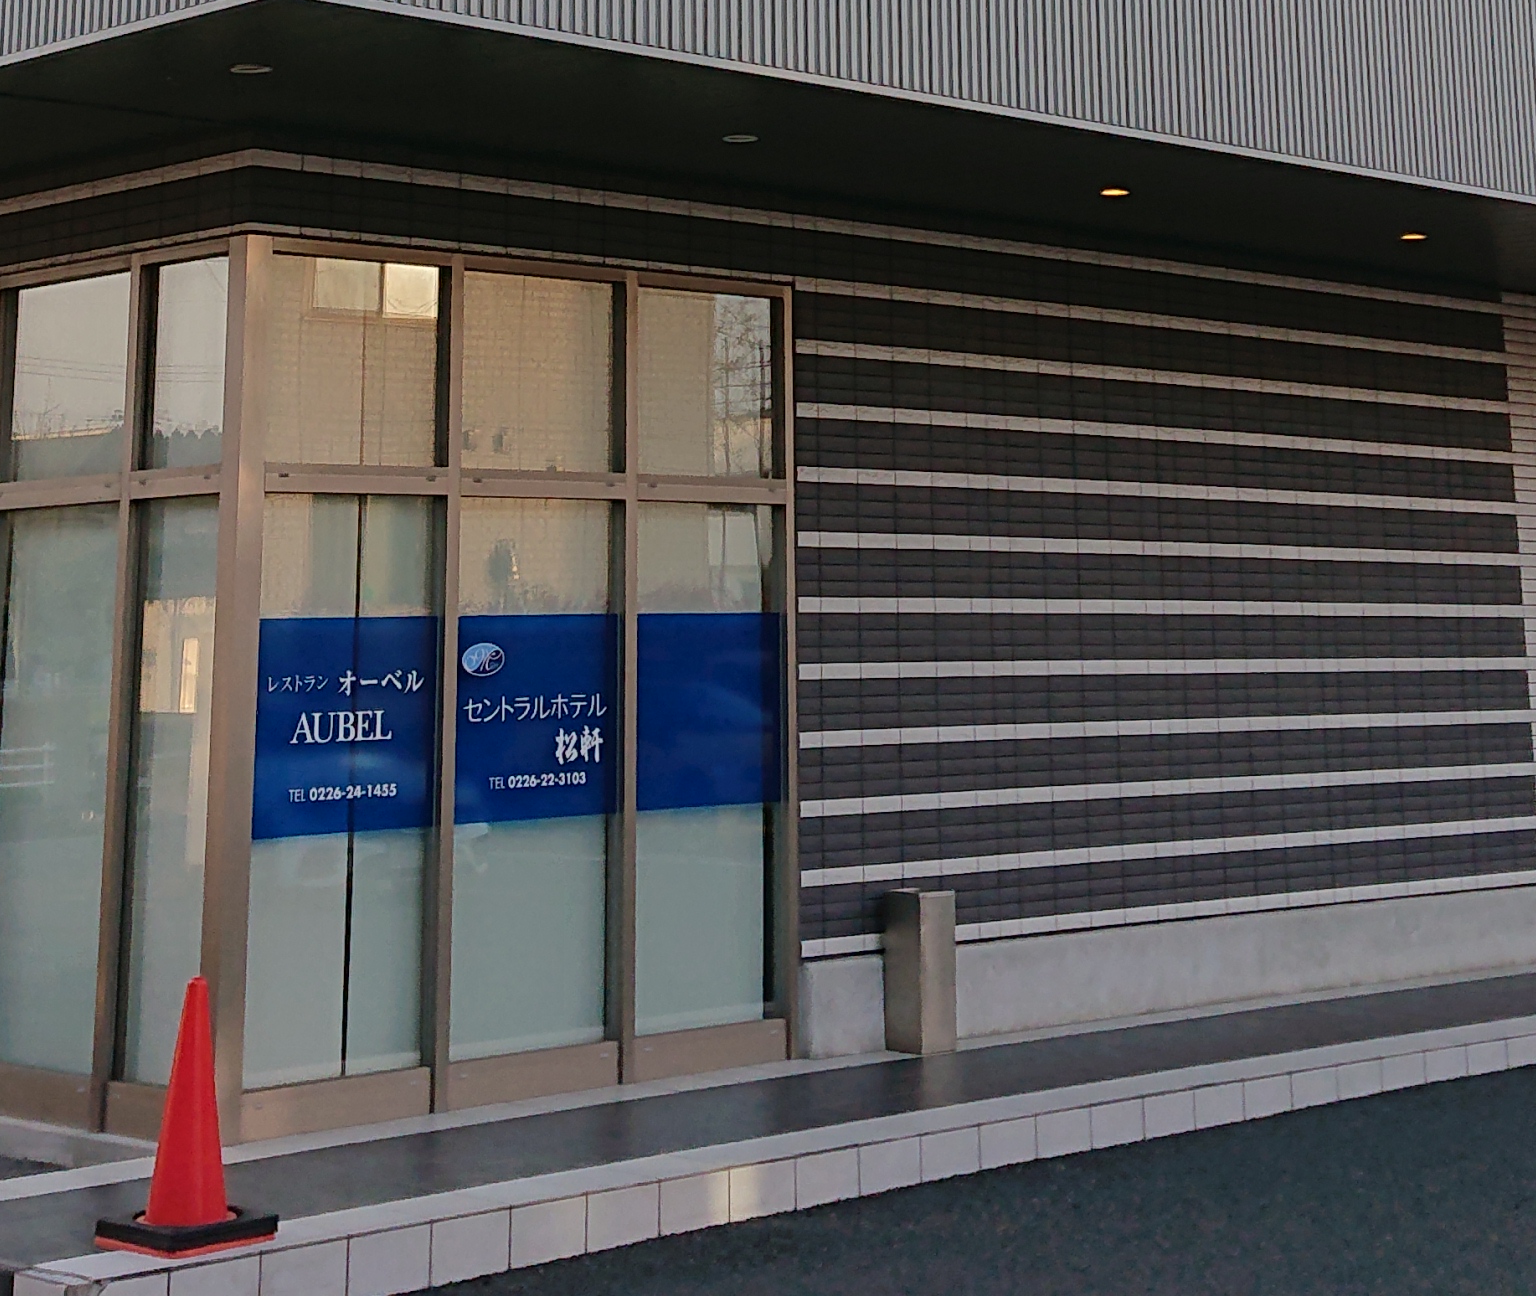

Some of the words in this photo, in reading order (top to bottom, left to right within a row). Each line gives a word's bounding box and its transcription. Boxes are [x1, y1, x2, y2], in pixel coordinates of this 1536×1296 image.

[267, 674, 329, 693] レストラン
[338, 669, 425, 697] オーベル
[463, 693, 608, 722] セントラルホテル
[289, 709, 392, 744] AUBEL
[289, 789, 306, 803] TEL
[309, 783, 397, 802] 0226-24-1455
[489, 776, 506, 790] TEL
[508, 771, 587, 789] 0226-22-3103
